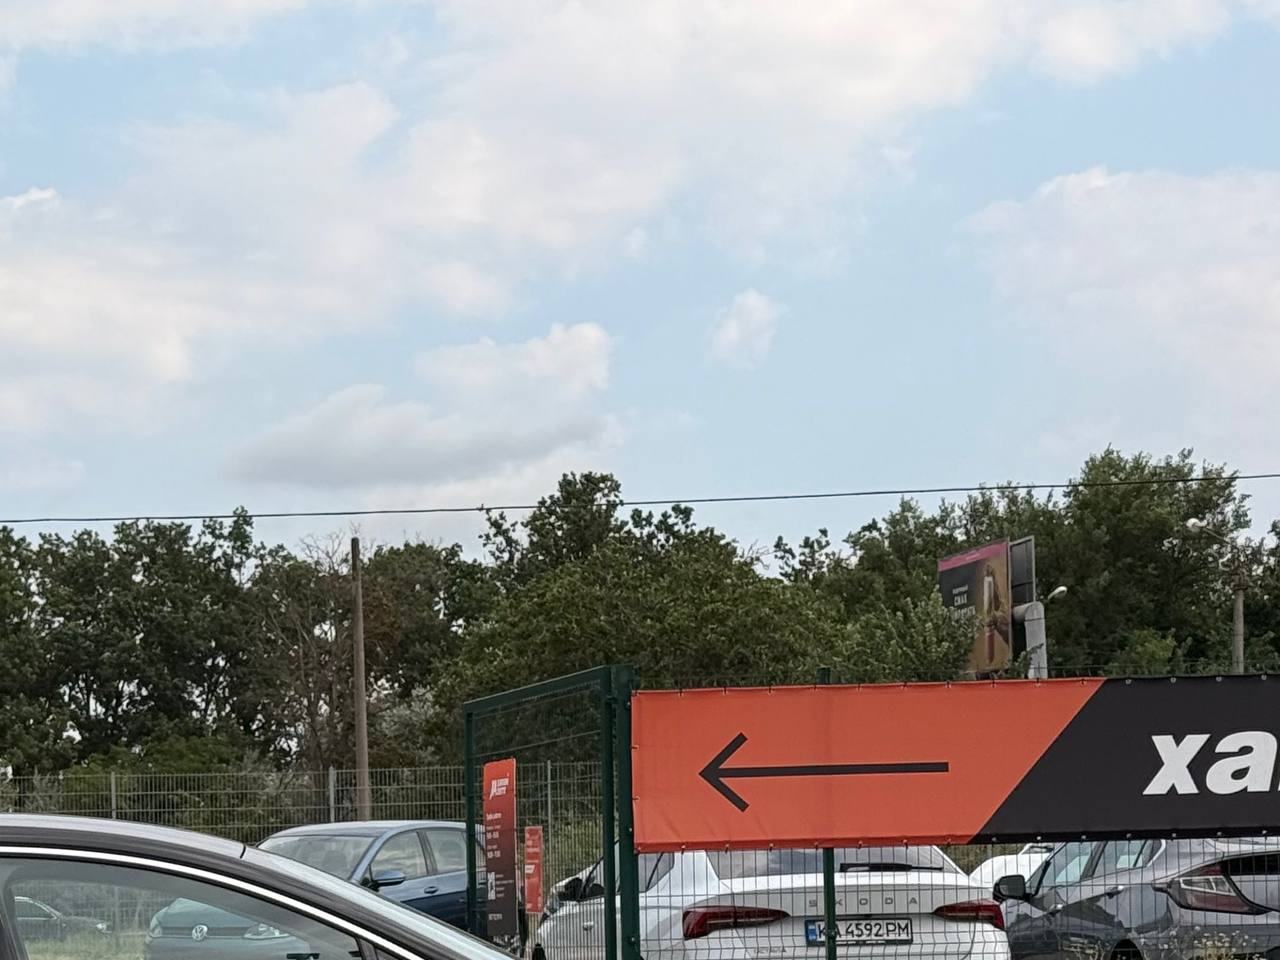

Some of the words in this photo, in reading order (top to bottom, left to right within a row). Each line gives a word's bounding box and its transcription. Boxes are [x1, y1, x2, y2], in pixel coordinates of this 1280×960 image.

[1142, 731, 1280, 795] ха
[846, 922, 883, 938] 4592
[886, 922, 910, 937] PM
